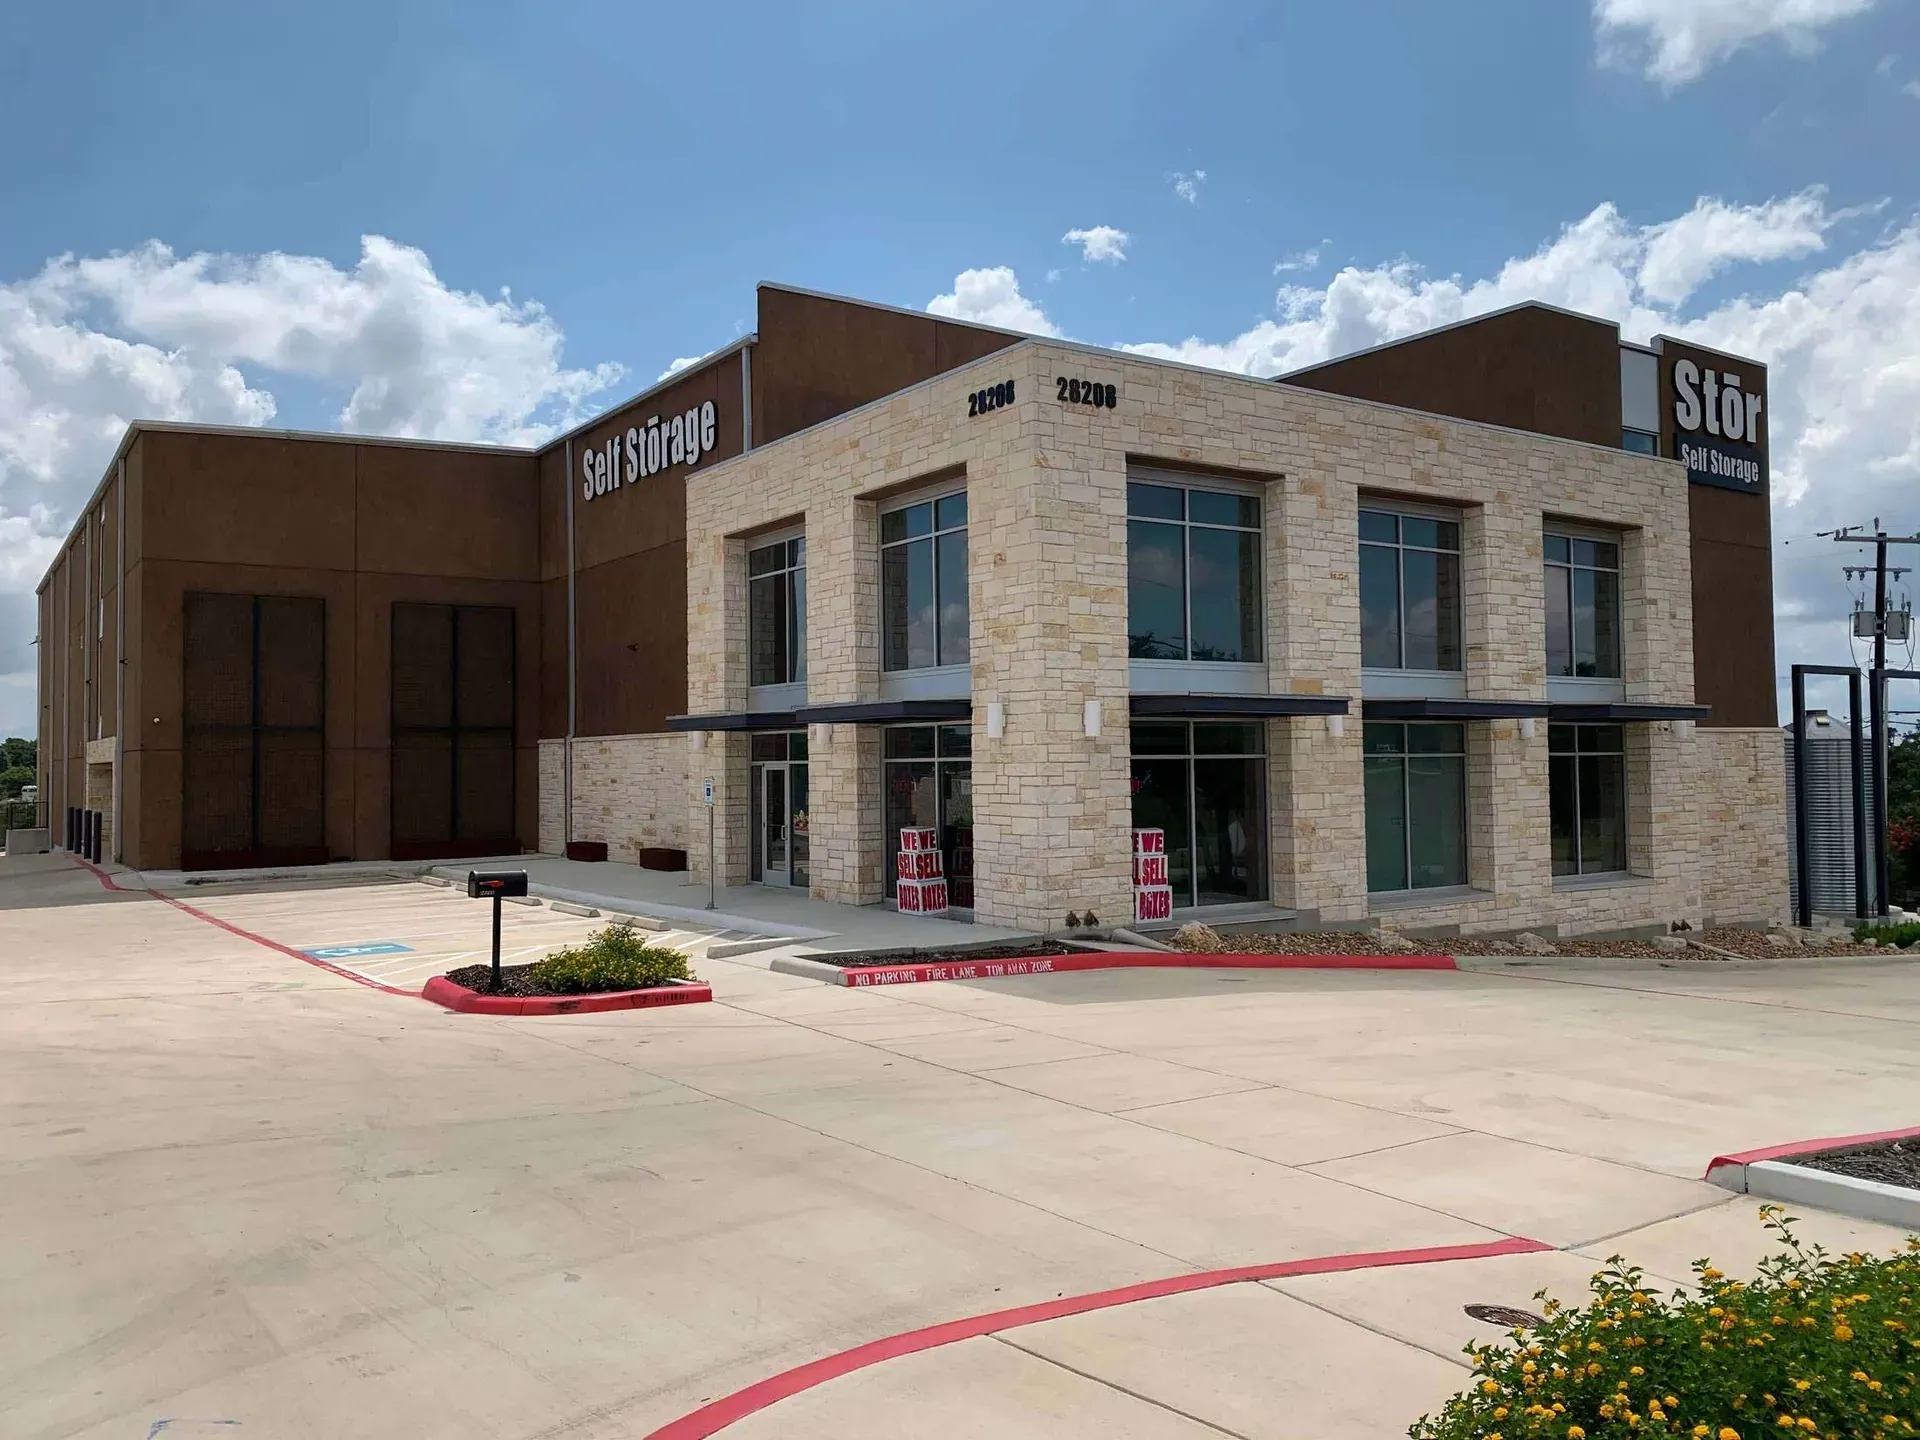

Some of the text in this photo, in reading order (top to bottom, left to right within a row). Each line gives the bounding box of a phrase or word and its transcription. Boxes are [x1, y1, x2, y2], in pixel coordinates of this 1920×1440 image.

[968, 379, 1015, 417] 28208
[1056, 376, 1117, 409] 28208
[583, 435, 621, 501] Self
[1682, 443, 1759, 483] Self Storage
[902, 832, 918, 851] WE
[919, 830, 937, 851] WE
[1141, 832, 1163, 852] WE
[898, 853, 916, 880] SELL
[916, 852, 942, 880] SELL
[1142, 857, 1167, 886] SELL
[899, 884, 920, 912] BOXES
[922, 883, 947, 912] BOXES
[855, 974, 870, 986] NO
[874, 970, 917, 985] PARKING
[926, 968, 949, 981] FIRE
[951, 966, 978, 979] LANE
[1030, 960, 1054, 973] ZONE
